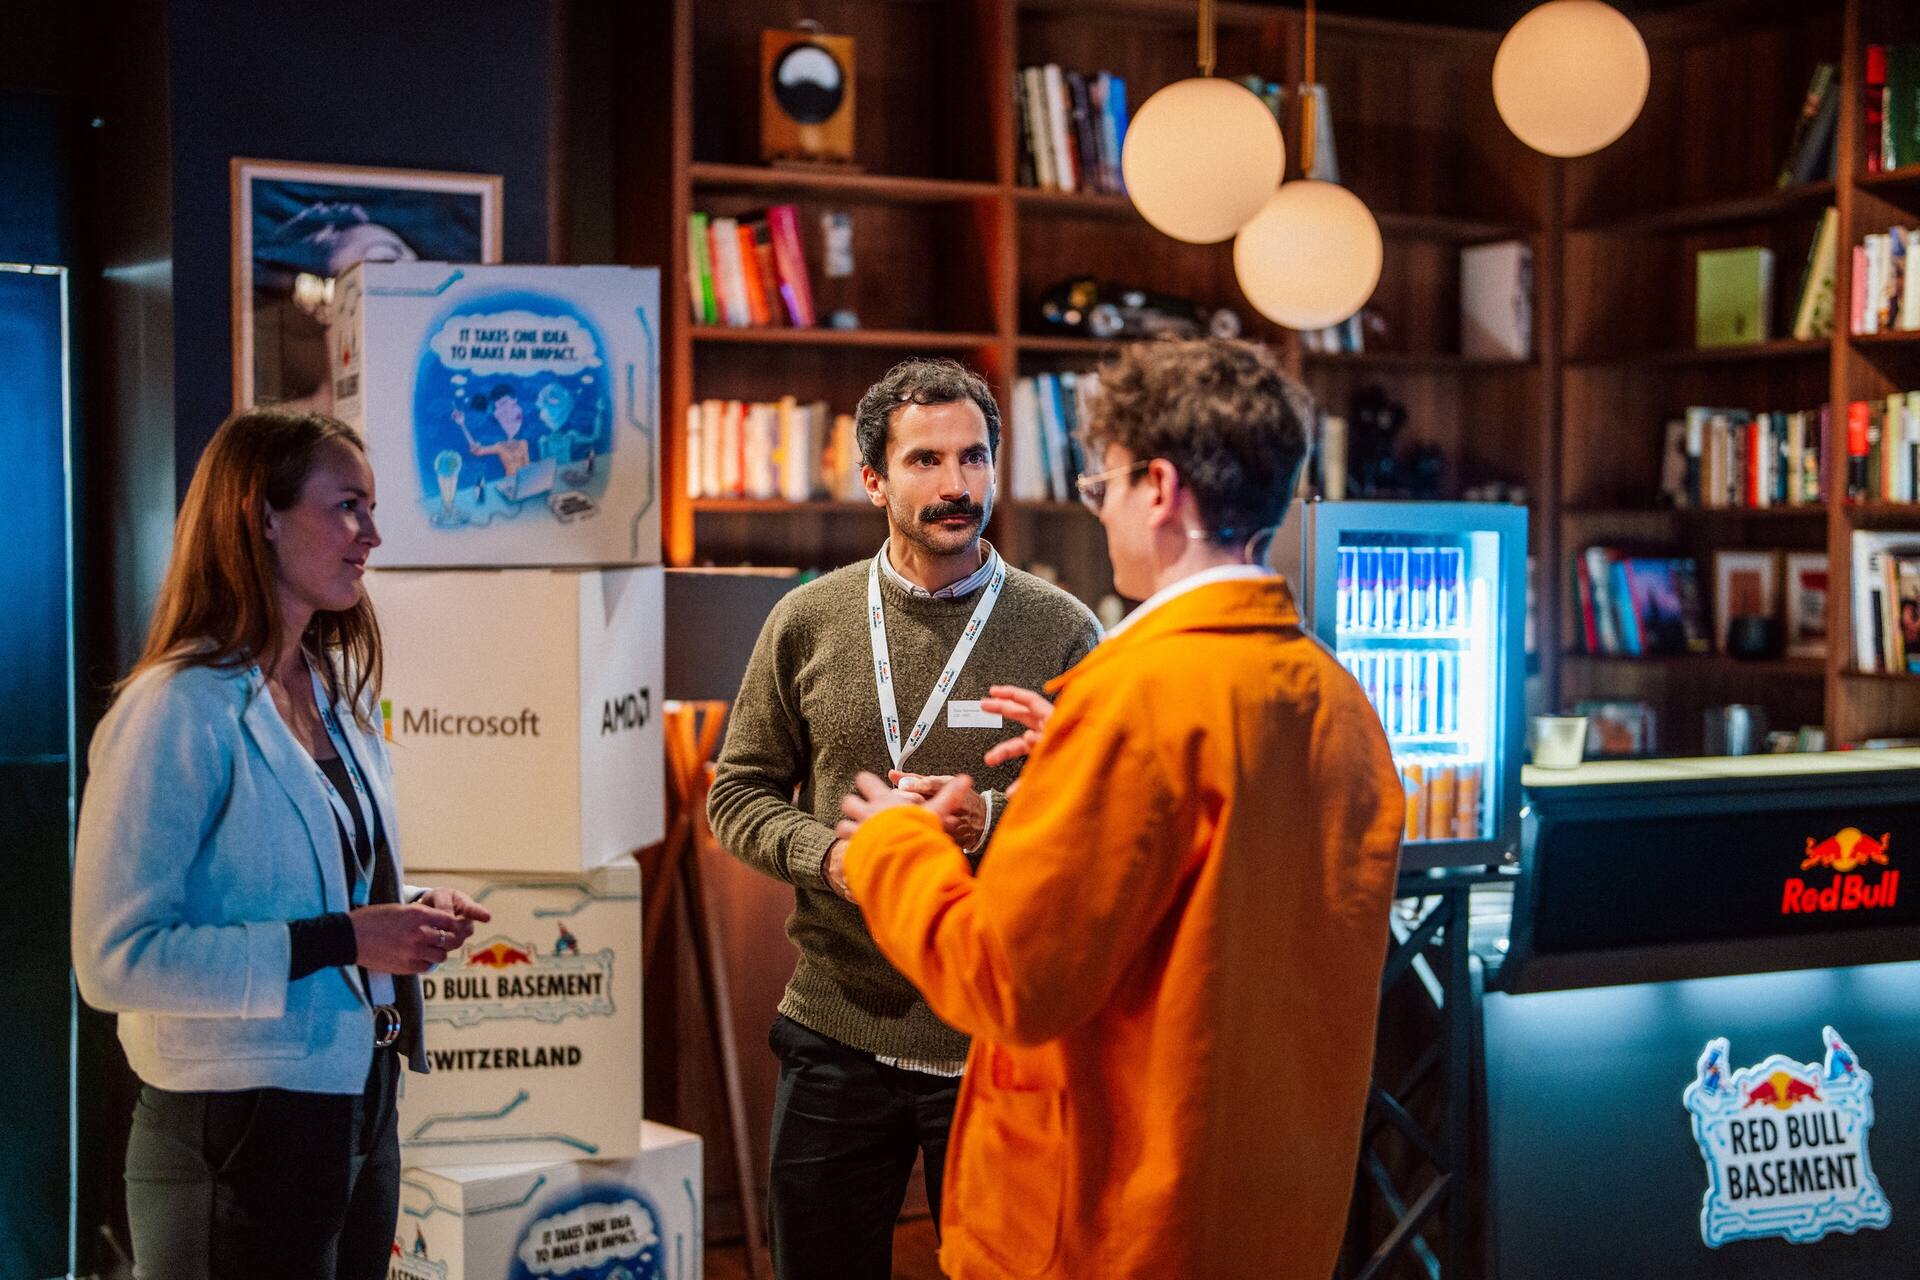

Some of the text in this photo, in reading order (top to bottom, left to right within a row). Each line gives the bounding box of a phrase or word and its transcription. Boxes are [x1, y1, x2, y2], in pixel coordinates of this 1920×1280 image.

[451, 345, 467, 359] TO
[471, 346, 504, 359] MAKE
[509, 347, 527, 360] AN
[460, 328, 569, 343] IT TAKES ONE IDEA
[402, 708, 540, 737] Microsoft
[601, 693, 638, 735] AMD
[1782, 869, 1900, 915] Red Bull
[444, 976, 491, 999] BULL
[497, 973, 602, 998] BASEMENT
[1729, 1111, 1846, 1155] RED BULL
[1727, 1153, 1859, 1200] BASEMENT
